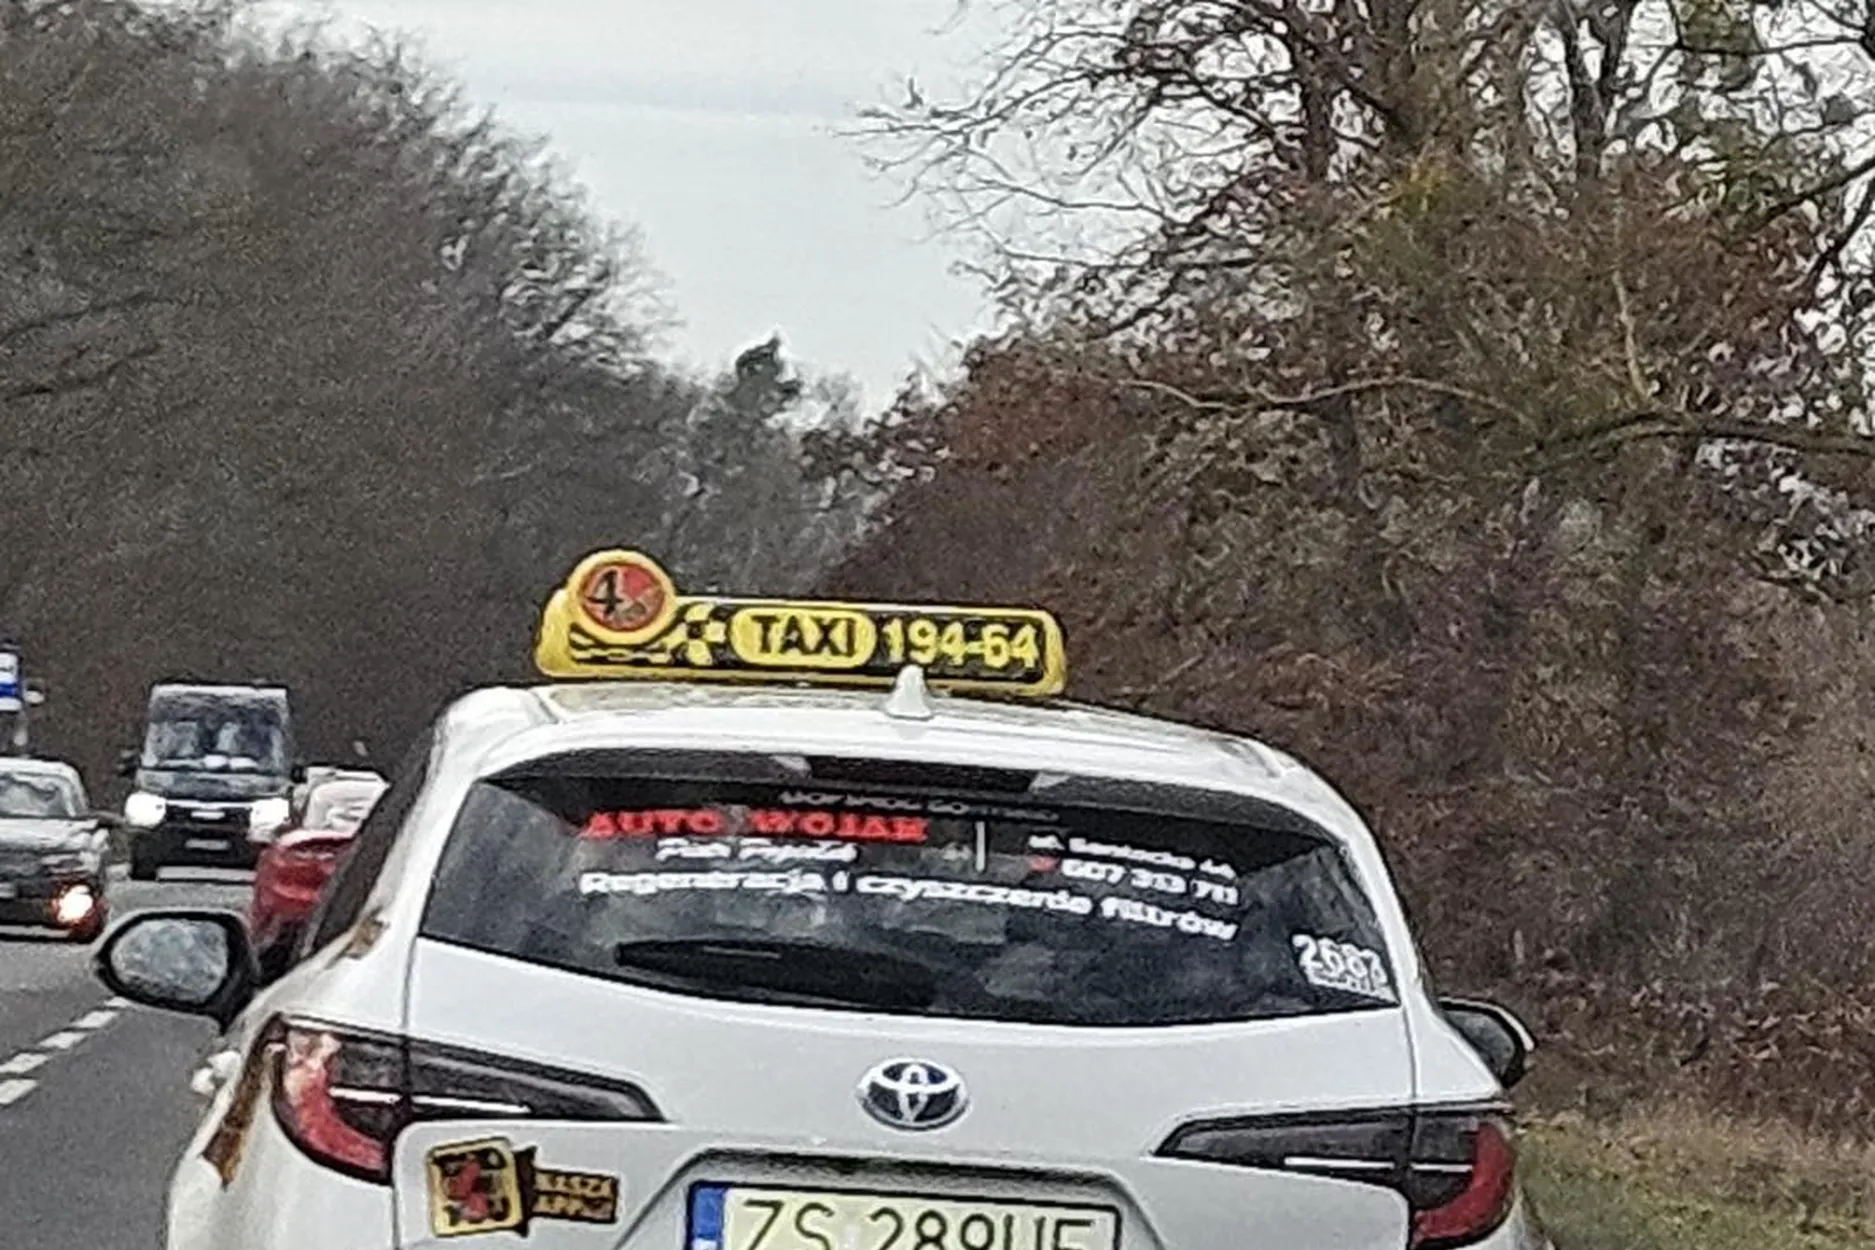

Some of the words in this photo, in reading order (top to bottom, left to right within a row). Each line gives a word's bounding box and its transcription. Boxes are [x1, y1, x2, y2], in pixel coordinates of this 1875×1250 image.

[751, 615, 857, 656] TAXI
[883, 616, 1038, 668] 194-64
[580, 809, 724, 839] AUTO
